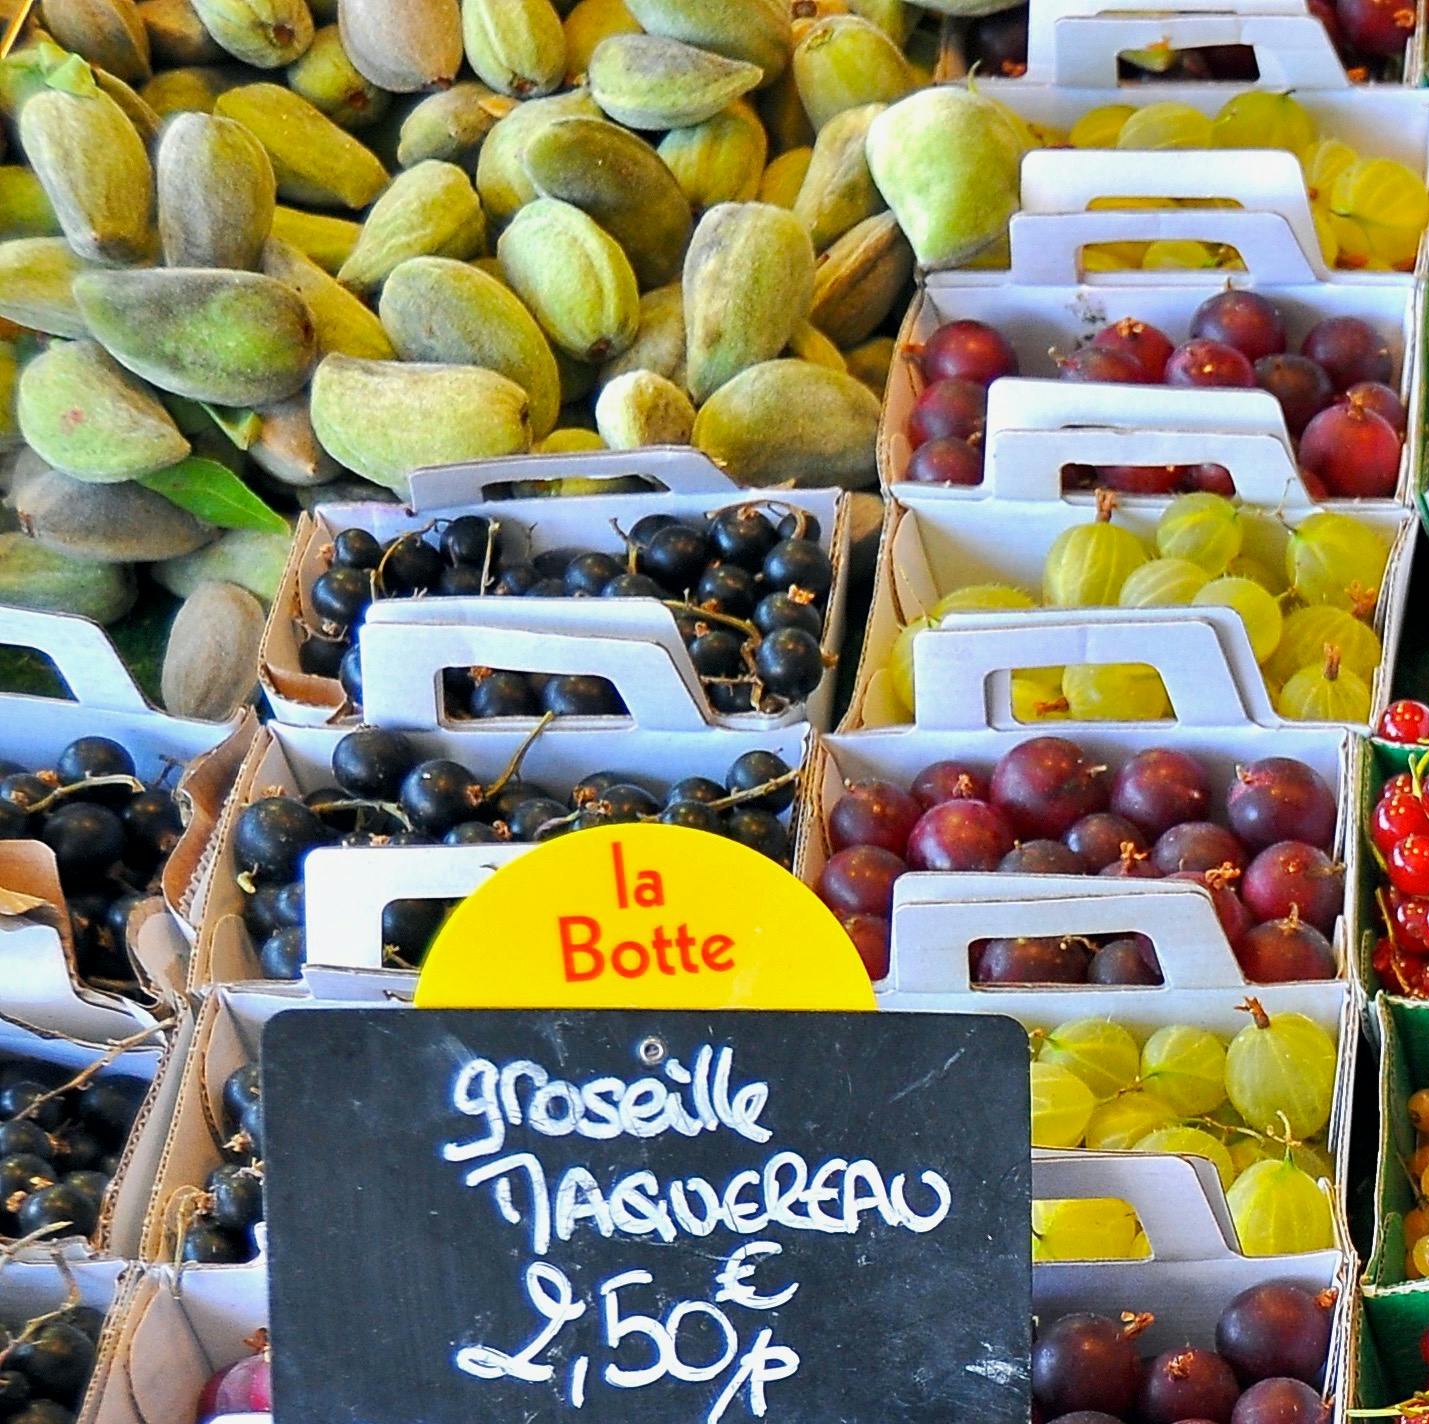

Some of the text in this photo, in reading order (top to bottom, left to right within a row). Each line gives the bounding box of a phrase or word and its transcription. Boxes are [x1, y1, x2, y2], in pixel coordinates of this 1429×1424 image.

[610, 841, 665, 908] la
[559, 915, 736, 982] Botte
[444, 1044, 773, 1162] groseille
